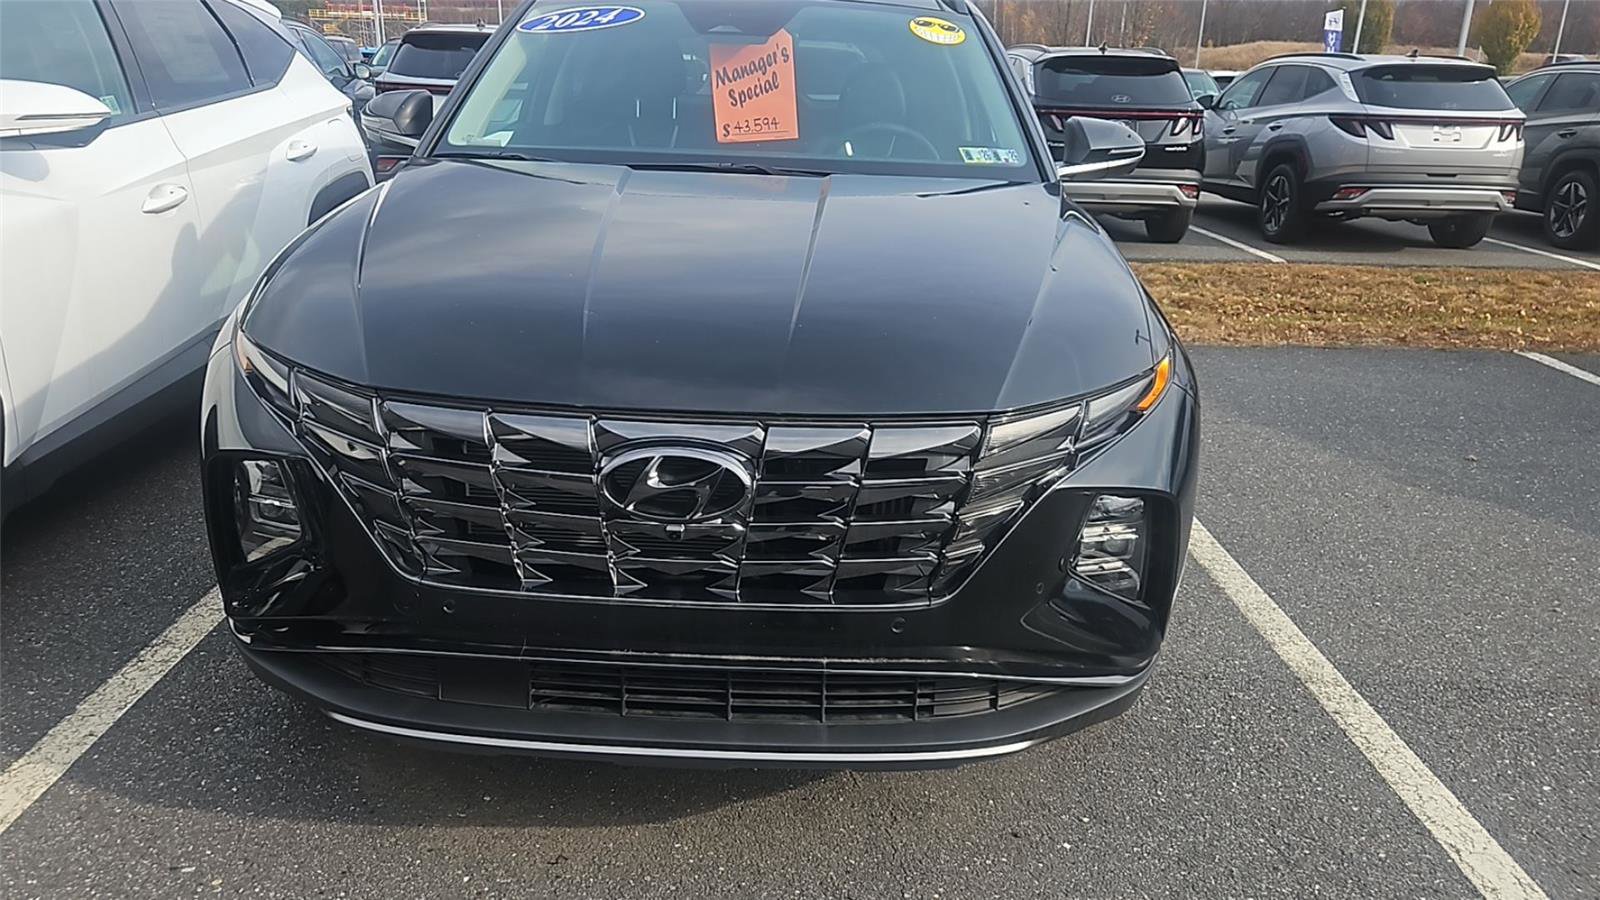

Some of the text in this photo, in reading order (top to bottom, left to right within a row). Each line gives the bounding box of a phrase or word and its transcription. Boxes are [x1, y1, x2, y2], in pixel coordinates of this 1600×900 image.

[532, 8, 623, 31] 2024
[716, 43, 790, 89] Manager's
[728, 71, 780, 108] Special
